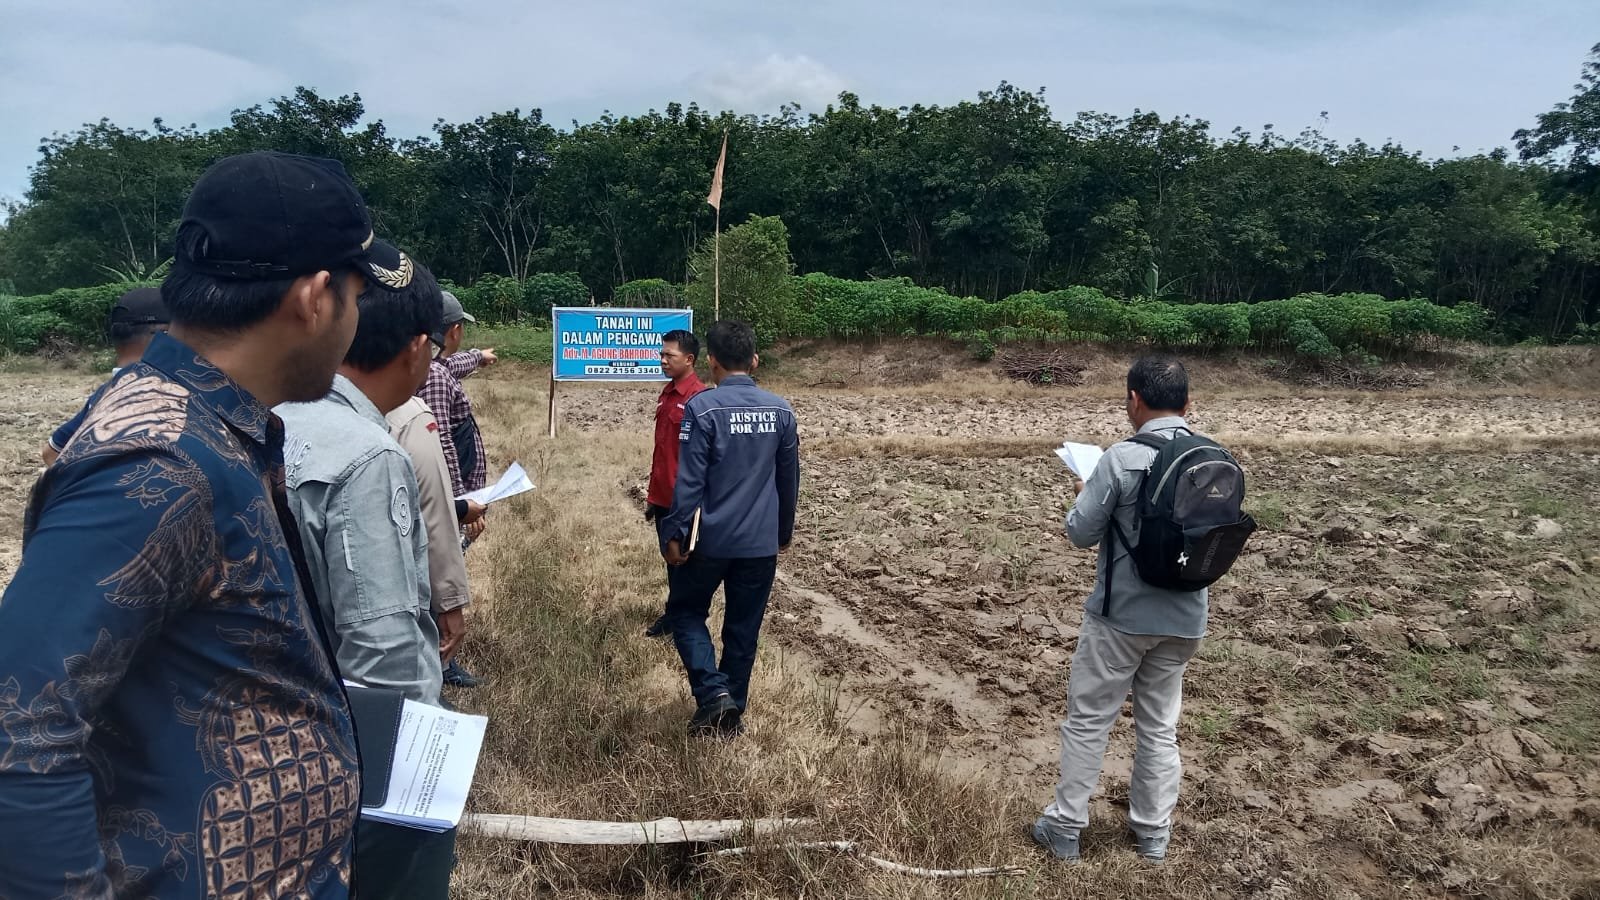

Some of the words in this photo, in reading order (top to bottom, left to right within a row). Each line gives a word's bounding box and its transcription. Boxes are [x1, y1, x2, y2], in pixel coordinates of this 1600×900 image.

[595, 316, 633, 330] TANAH
[637, 317, 653, 330] INI
[562, 331, 603, 345] DALAM
[607, 331, 665, 346] PENGAWA
[563, 347, 579, 360] Adv.
[591, 347, 618, 360] AGUNG
[730, 411, 777, 423] JUSTICE
[730, 423, 753, 434] FOR
[757, 422, 777, 433] ALL
